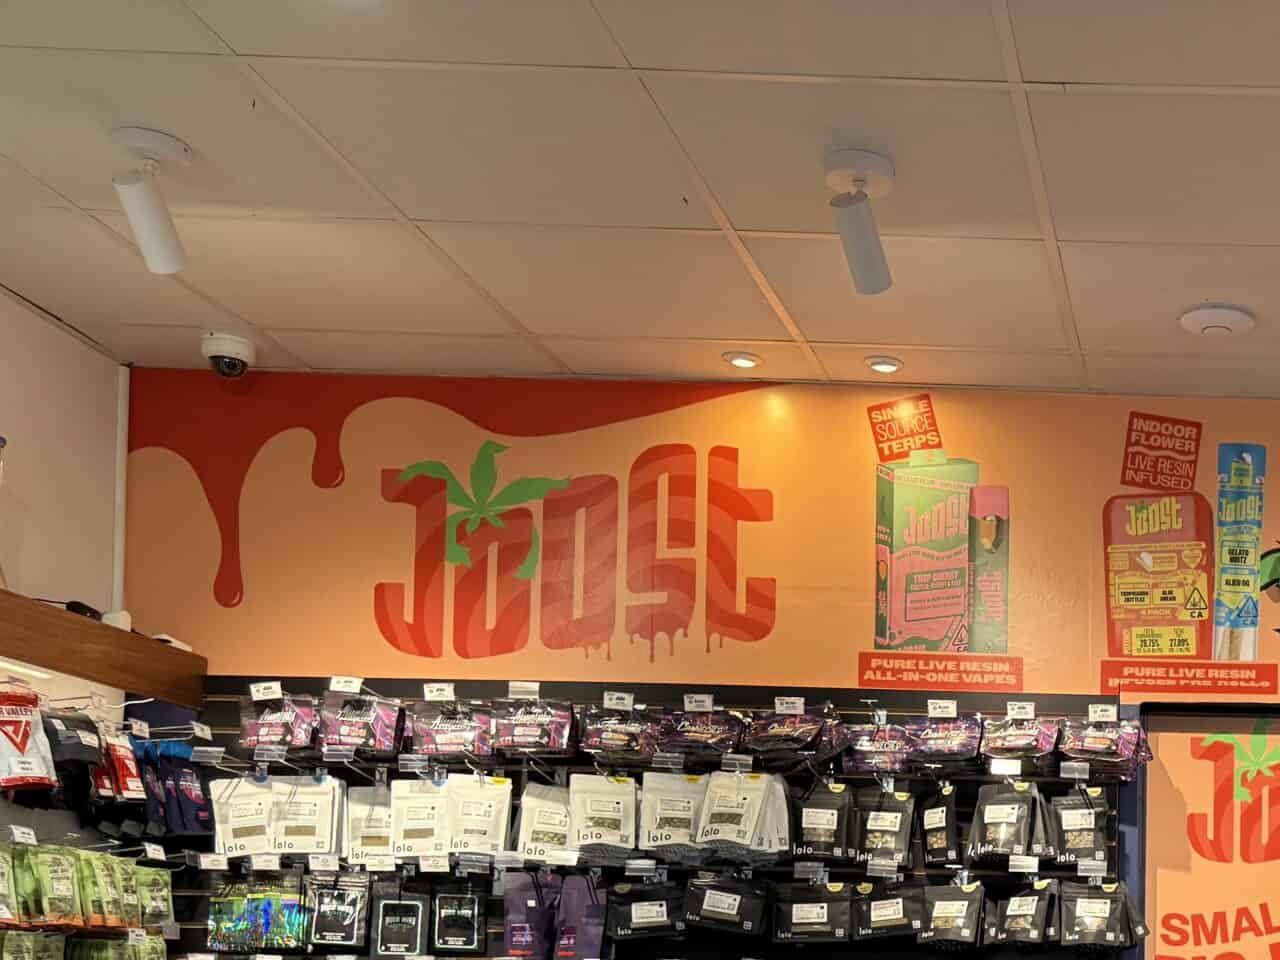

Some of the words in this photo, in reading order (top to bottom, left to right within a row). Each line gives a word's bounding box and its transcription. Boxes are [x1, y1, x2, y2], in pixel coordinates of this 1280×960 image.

[871, 400, 931, 423] SINLE
[876, 414, 934, 441] SOURCE
[1133, 418, 1197, 439] INDOOR
[879, 432, 940, 456] TERPS
[1130, 431, 1196, 452] FLOWER
[1127, 452, 1157, 473] LIVE
[1158, 457, 1195, 478] RESIN
[1125, 470, 1192, 490] INFUSED
[1190, 611, 1204, 619] CA
[870, 658, 916, 670] PURE
[918, 660, 956, 671] LIVE
[958, 661, 1010, 672] RESIN
[864, 670, 958, 682] ALL-IN-ONE
[962, 673, 1017, 685] VAPES
[1123, 666, 1167, 677] PURE
[1169, 667, 1207, 678] LIVE
[1208, 668, 1256, 679] RESIN
[577, 829, 602, 841] lolo
[648, 830, 672, 842] lolo
[273, 836, 294, 850] lolo
[392, 840, 413, 852] lolo
[450, 837, 470, 849] lolo
[793, 843, 813, 855] lolo
